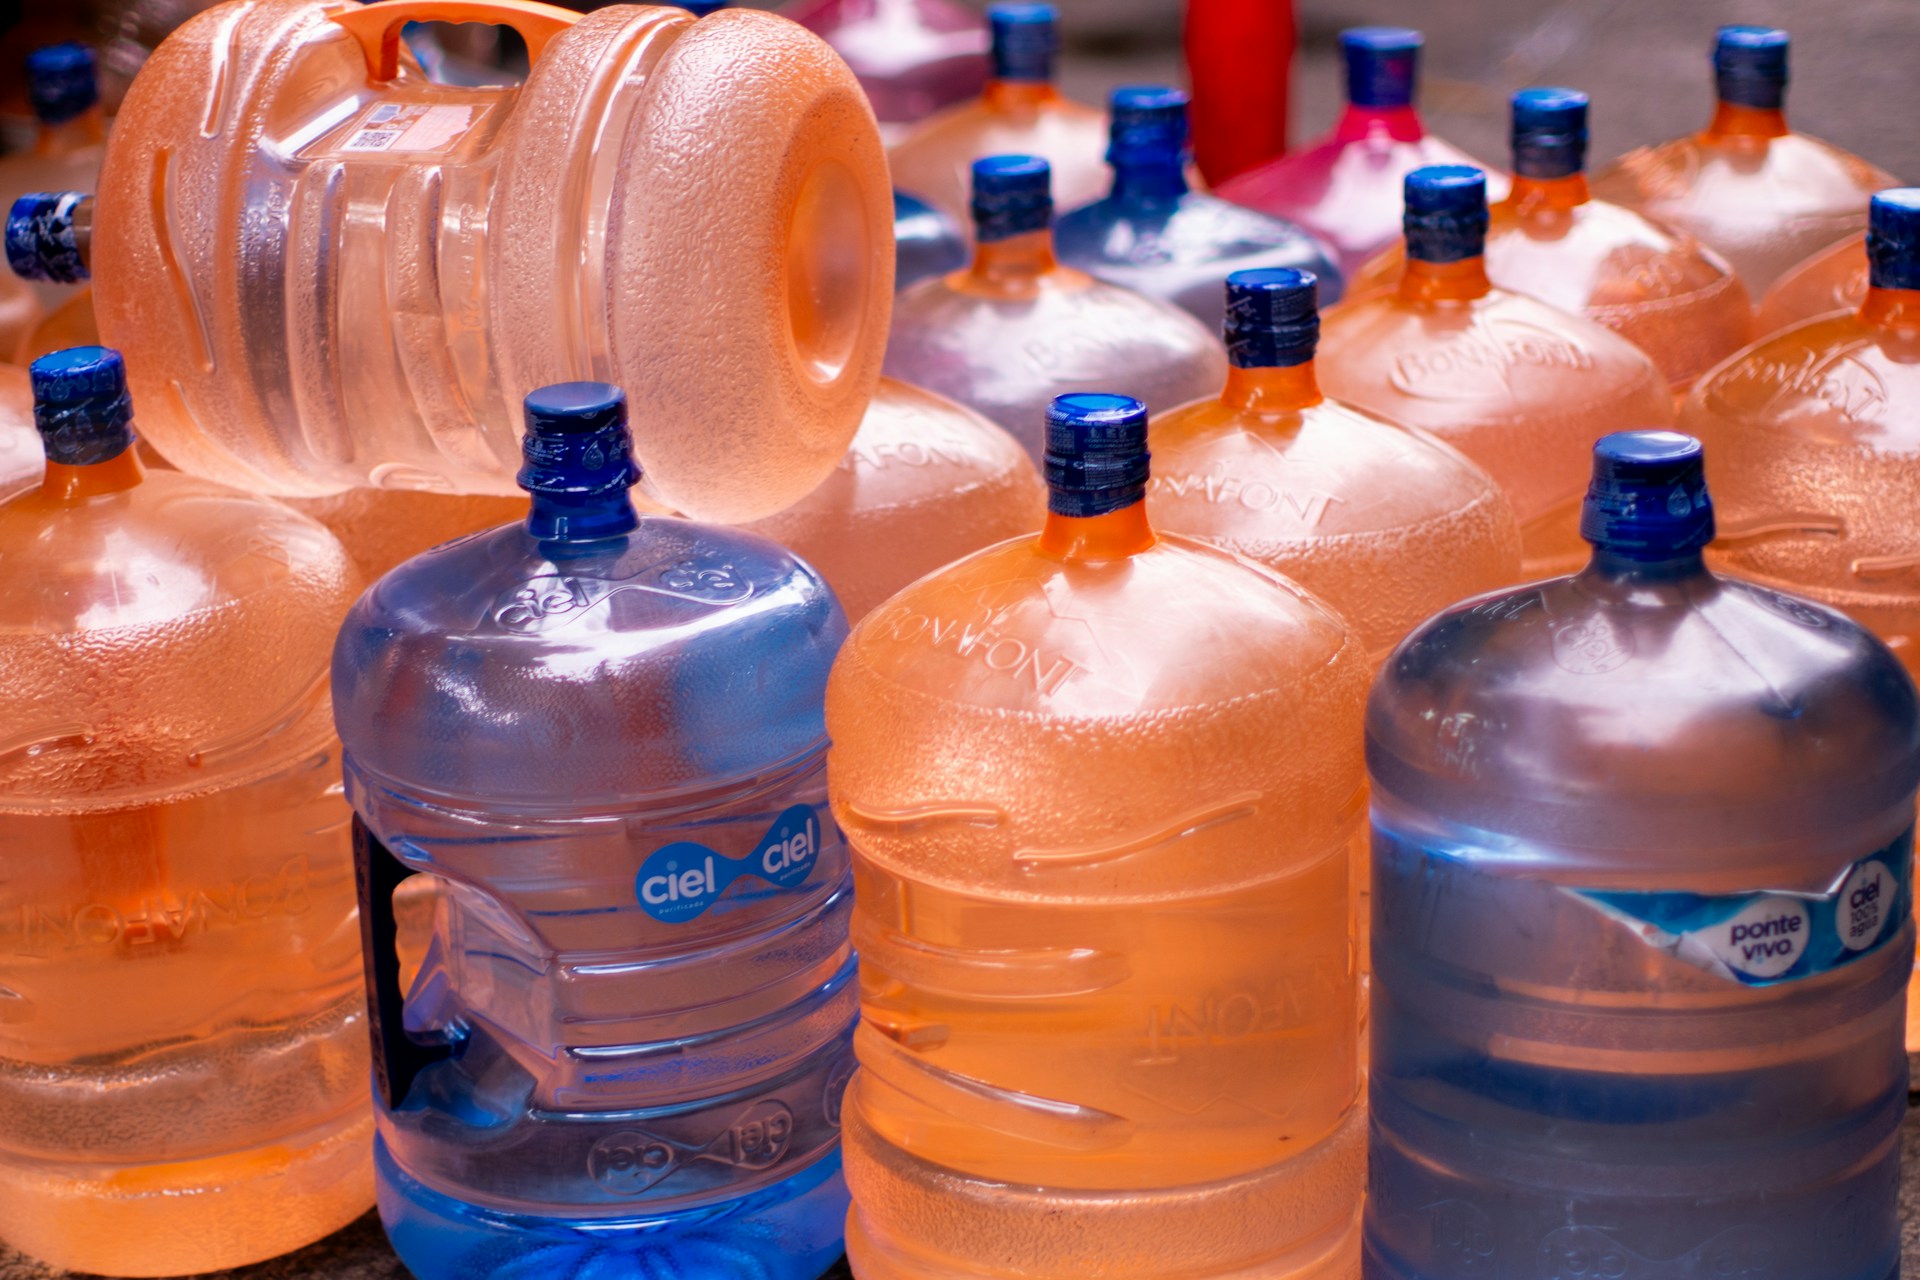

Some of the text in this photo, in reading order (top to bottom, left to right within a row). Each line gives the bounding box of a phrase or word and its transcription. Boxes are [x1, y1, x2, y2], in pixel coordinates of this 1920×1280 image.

[838, 438, 970, 471] AFONT
[1150, 470, 1346, 530] NAFONT
[494, 577, 589, 627] ciel
[641, 818, 814, 904] ciel ciel
[1850, 872, 1881, 909] ciel
[658, 901, 704, 915] purificada
[1730, 914, 1803, 947] ponte
[1849, 915, 1879, 938] agua
[1742, 938, 1793, 962] vivo
